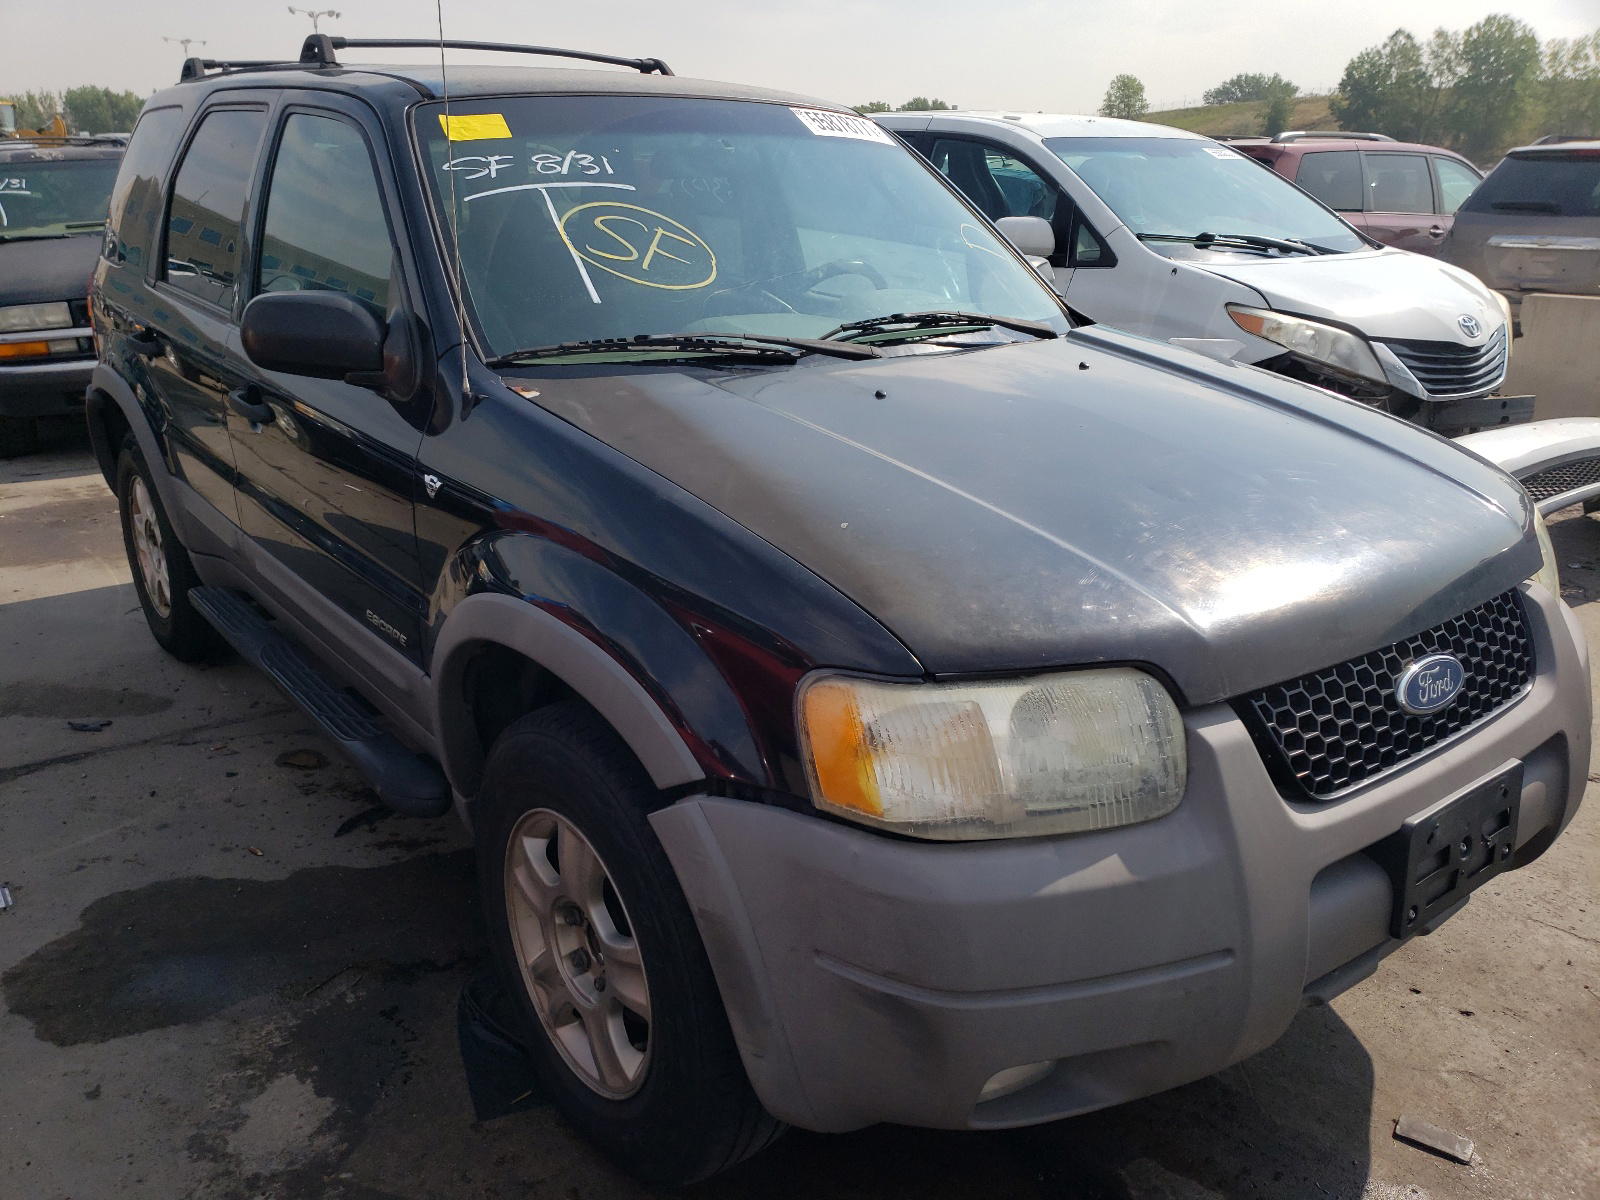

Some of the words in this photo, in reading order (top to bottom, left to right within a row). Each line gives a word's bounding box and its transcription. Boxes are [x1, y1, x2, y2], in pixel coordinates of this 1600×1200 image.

[442, 155, 516, 179] SF
[531, 149, 616, 175] 8/31
[586, 215, 697, 271] SF
[366, 608, 408, 647] ESCAPE
[1418, 665, 1454, 704] Ford
